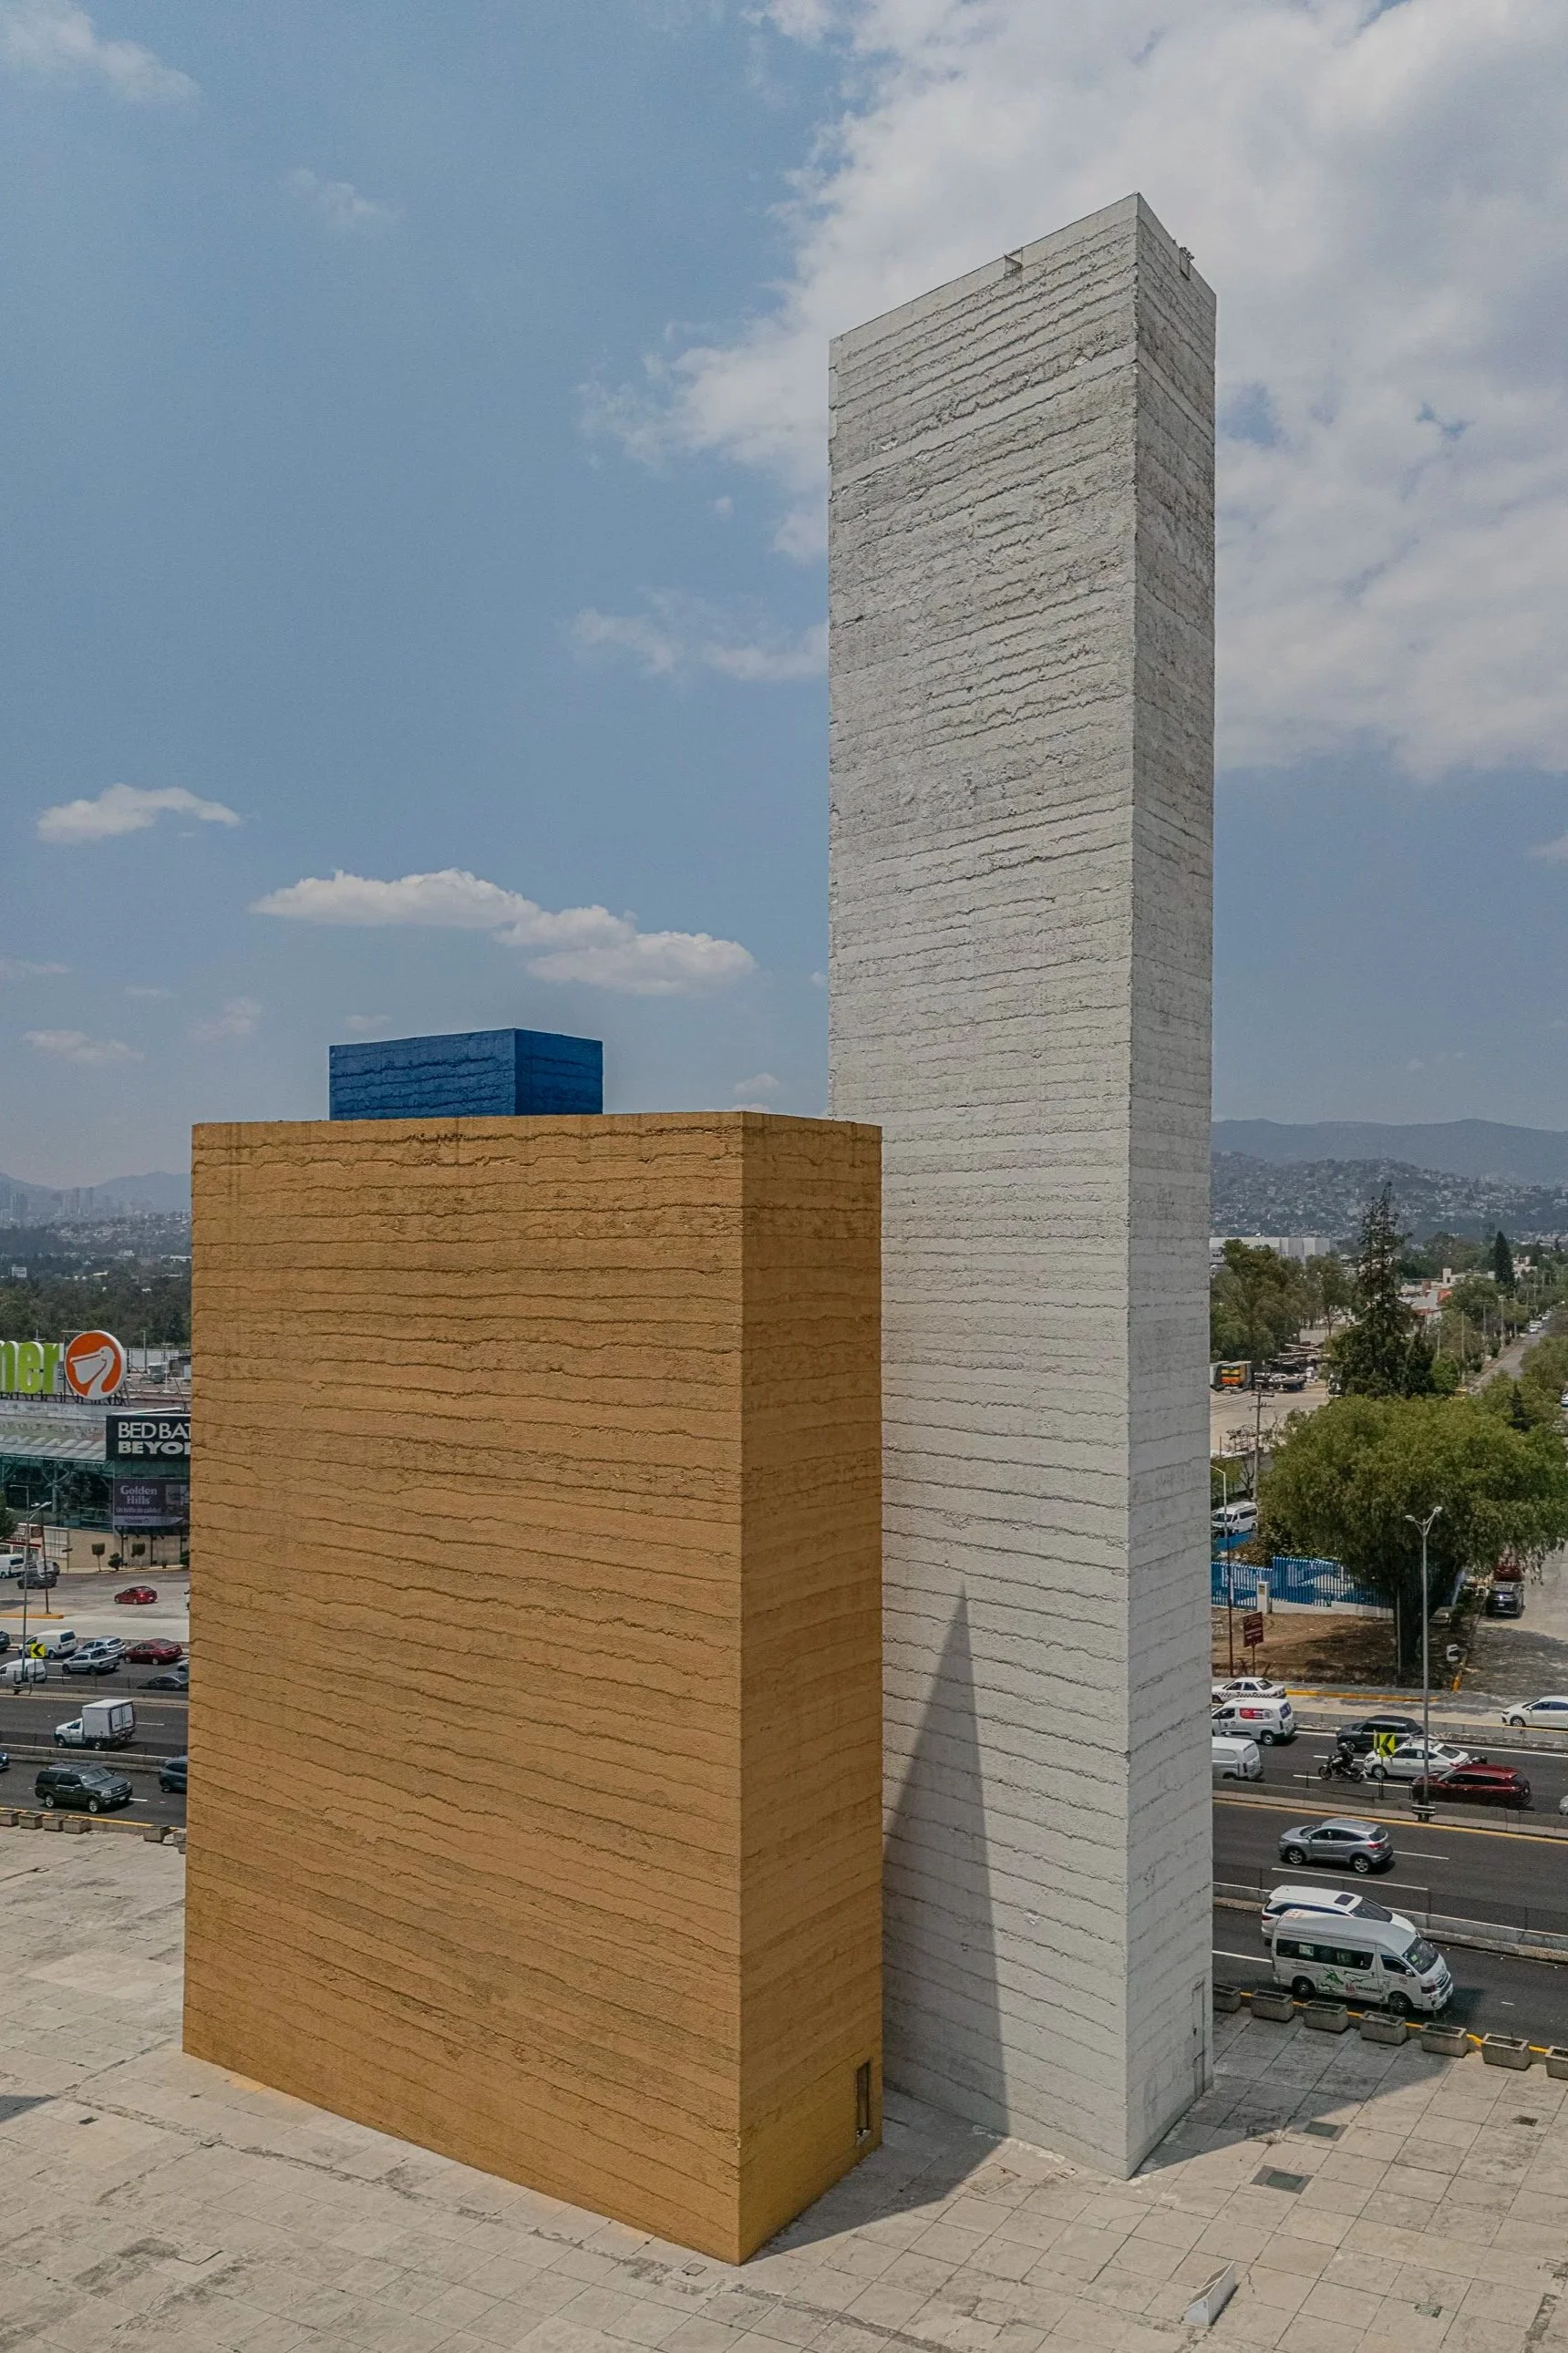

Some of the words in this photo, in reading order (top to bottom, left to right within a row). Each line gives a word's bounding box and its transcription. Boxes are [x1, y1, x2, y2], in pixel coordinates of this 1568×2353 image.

[118, 1422, 157, 1439] BED
[119, 1485, 158, 1495] Golden
[127, 1495, 150, 1505] Hills
